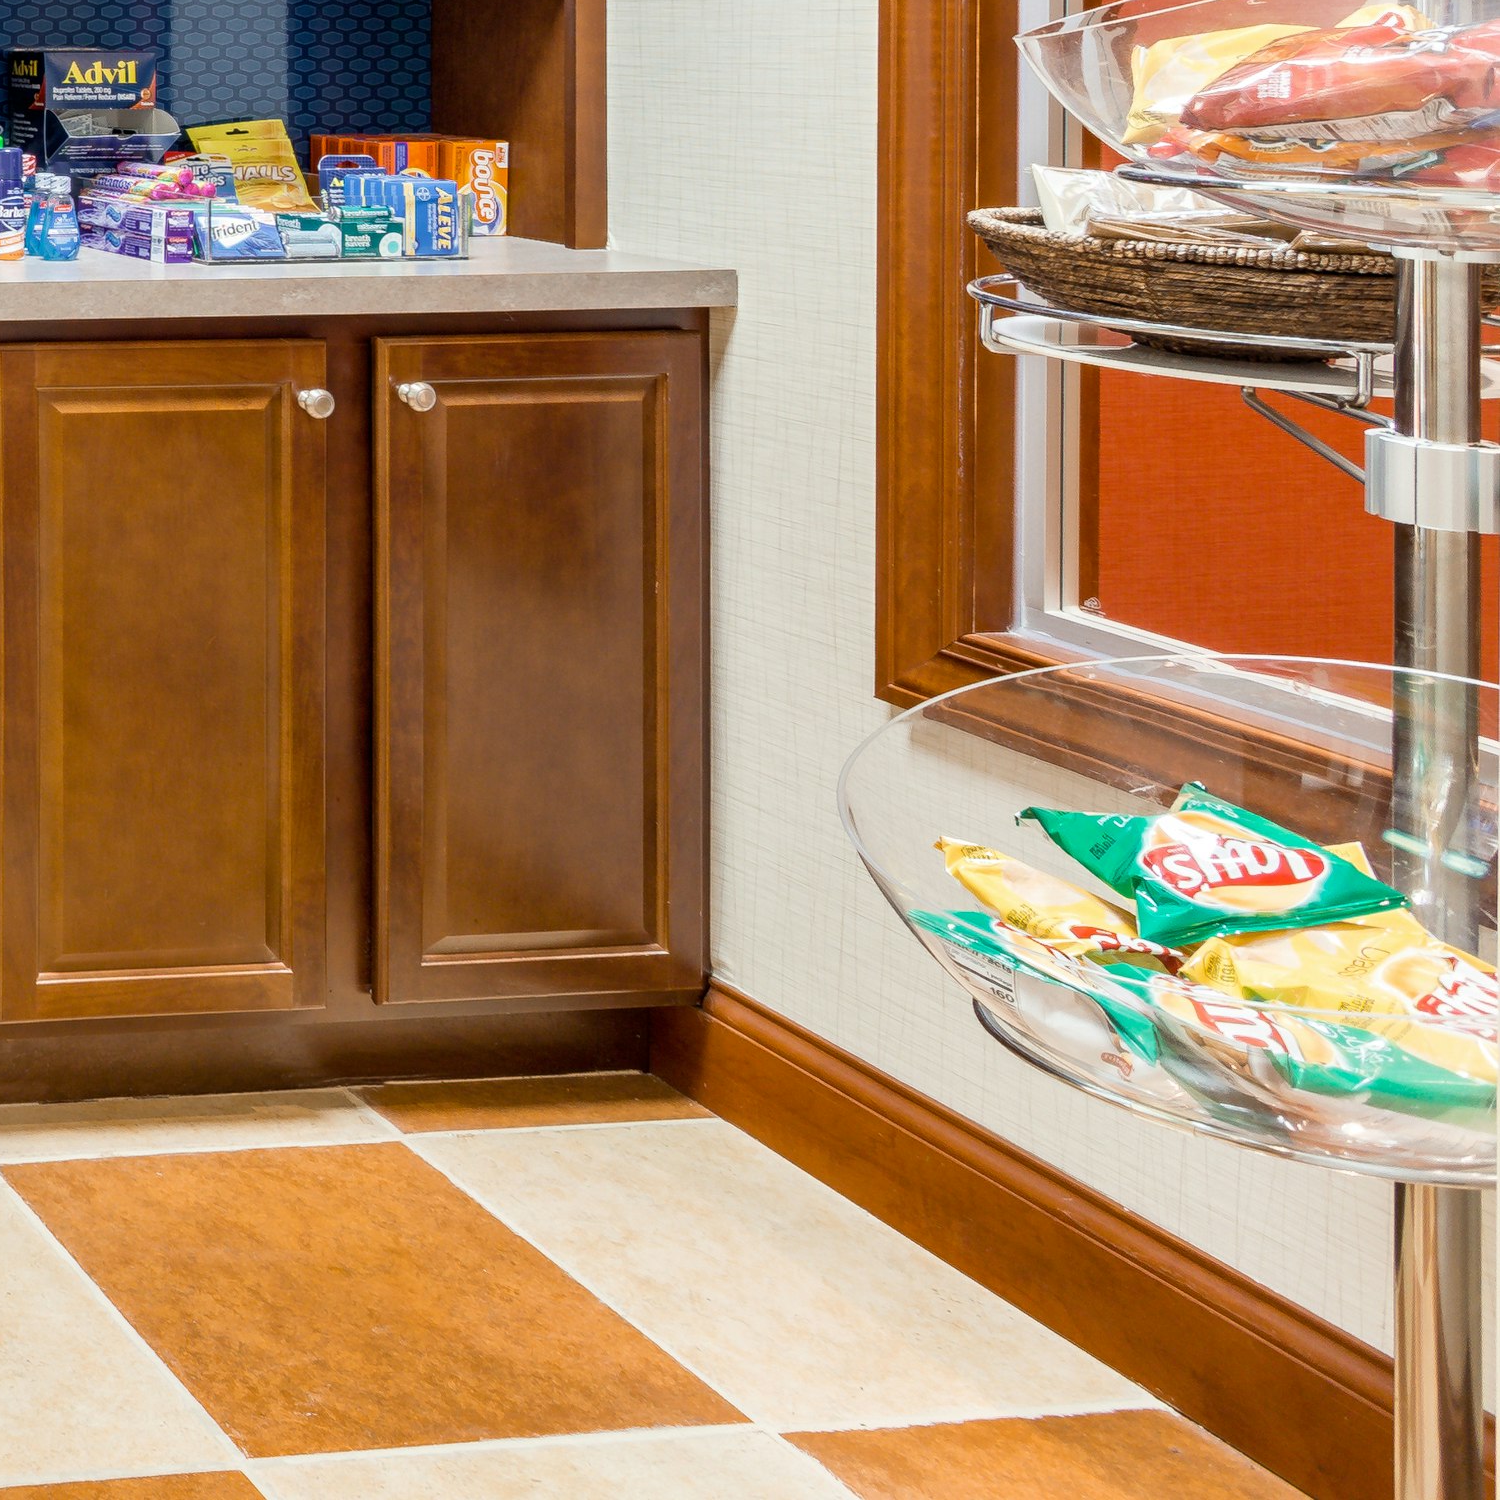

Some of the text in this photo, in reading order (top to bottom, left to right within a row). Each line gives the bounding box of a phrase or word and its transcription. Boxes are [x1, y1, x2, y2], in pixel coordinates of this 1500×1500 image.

[12, 60, 38, 77] Advil
[62, 60, 138, 85] Advil
[231, 164, 298, 183] HALLS
[469, 149, 497, 224] bounce
[210, 217, 259, 242] Trident
[435, 187, 454, 251] ALEVE
[344, 233, 371, 243] breath
[1162, 836, 1315, 893] Lay's
[989, 986, 1015, 1004] 160
